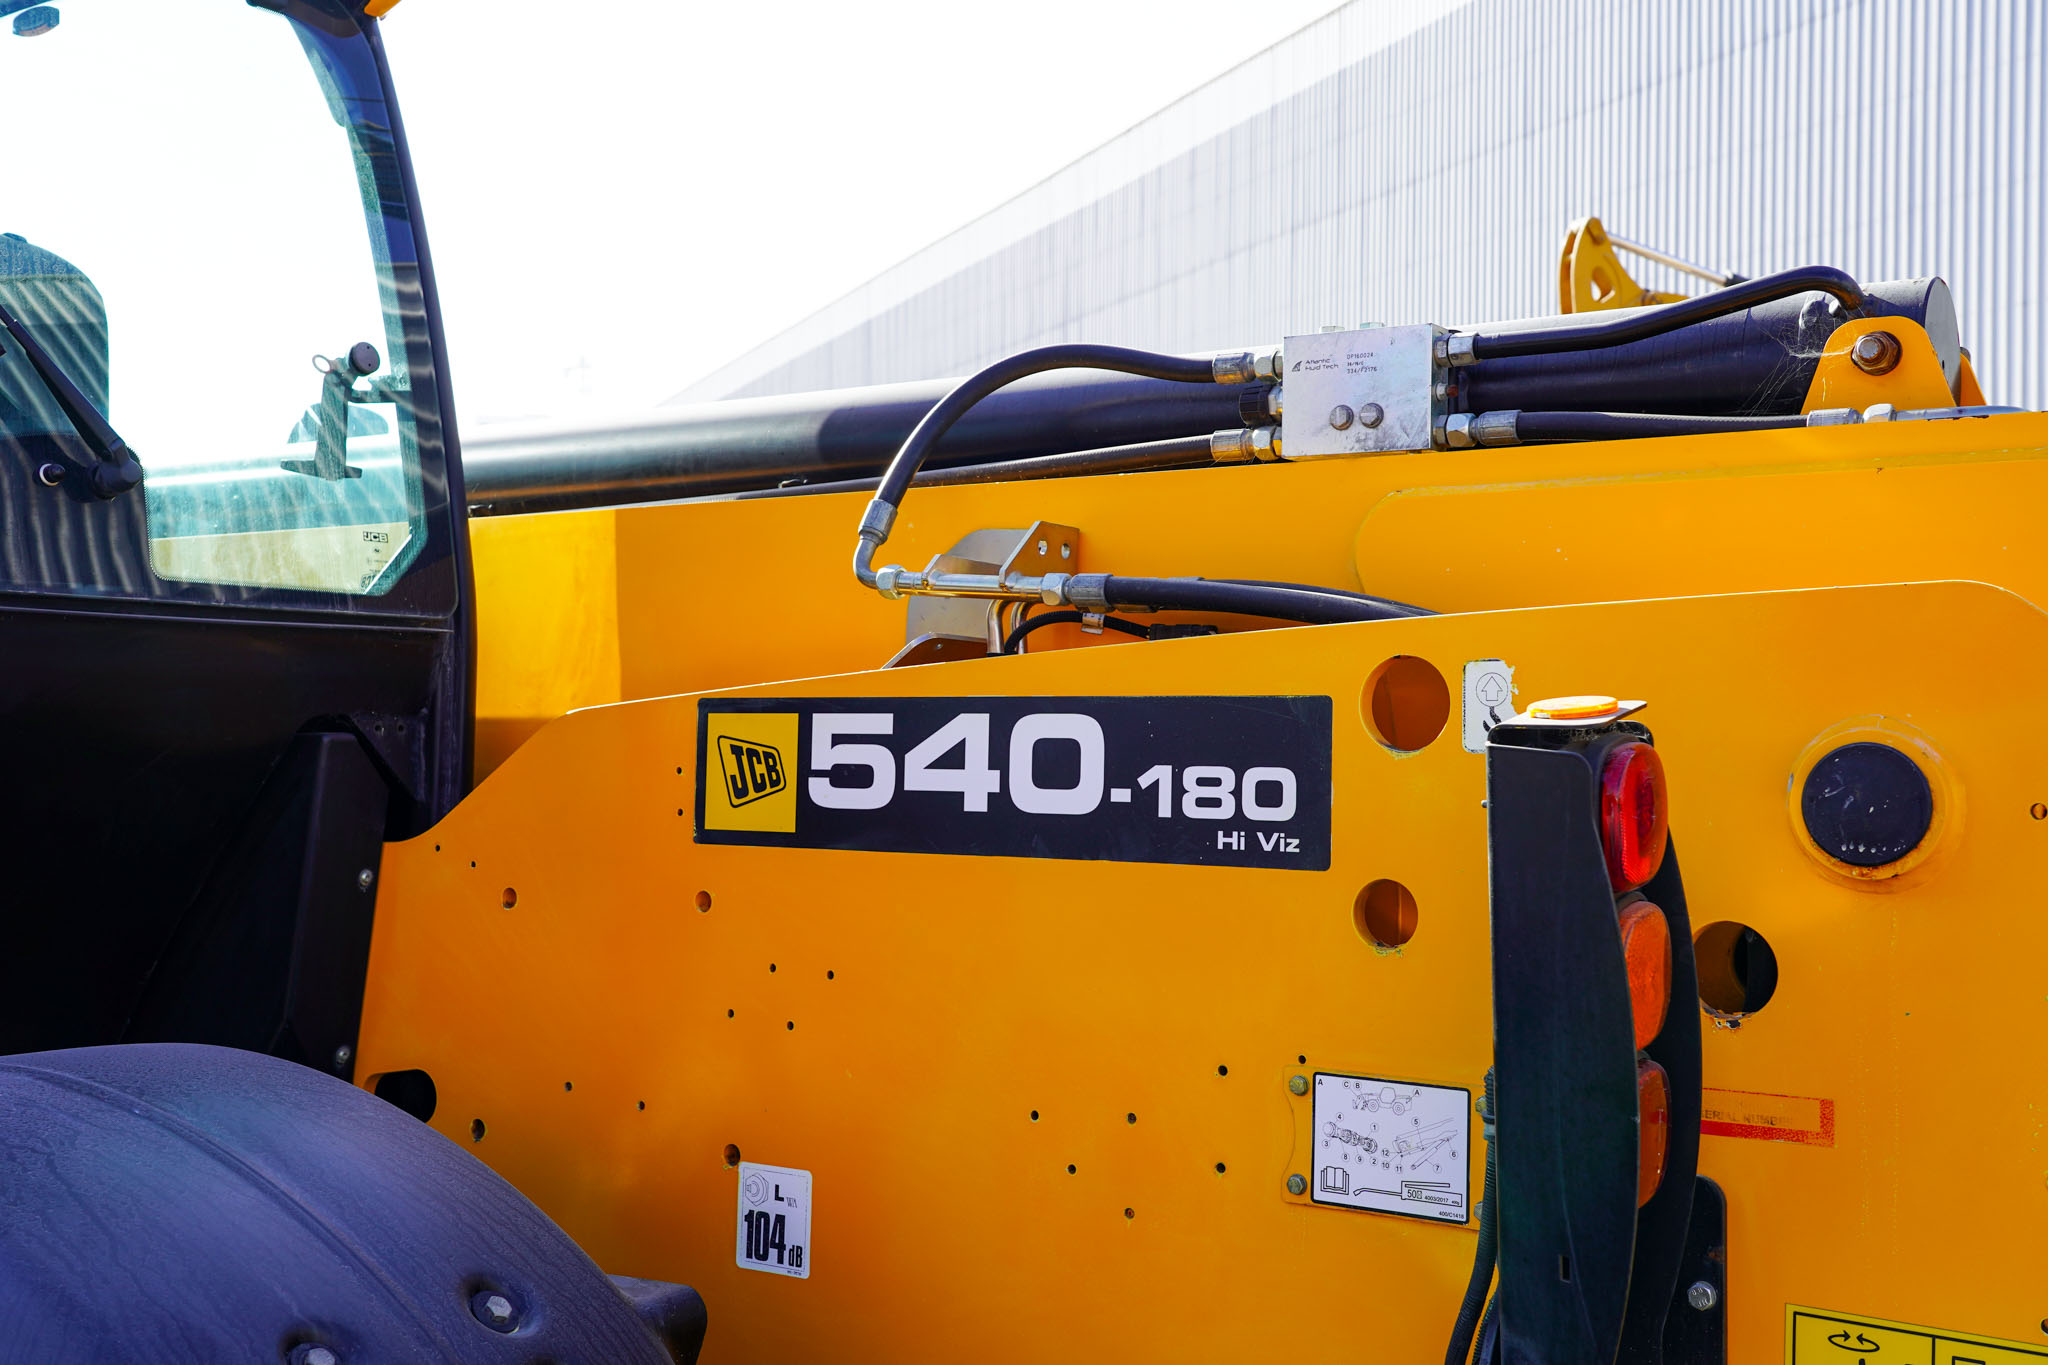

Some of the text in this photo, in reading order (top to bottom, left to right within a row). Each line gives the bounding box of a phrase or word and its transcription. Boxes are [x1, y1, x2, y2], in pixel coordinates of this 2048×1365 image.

[363, 531, 389, 543] JCB
[729, 743, 782, 800] JCB
[1217, 830, 1300, 853] Hi Viz
[1318, 1078, 1324, 1086] A
[1701, 1109, 1740, 1122] ERIAL
[1357, 1155, 1362, 1163] 9
[1381, 1149, 1390, 1157] 12
[744, 1209, 803, 1268] 104 dB
